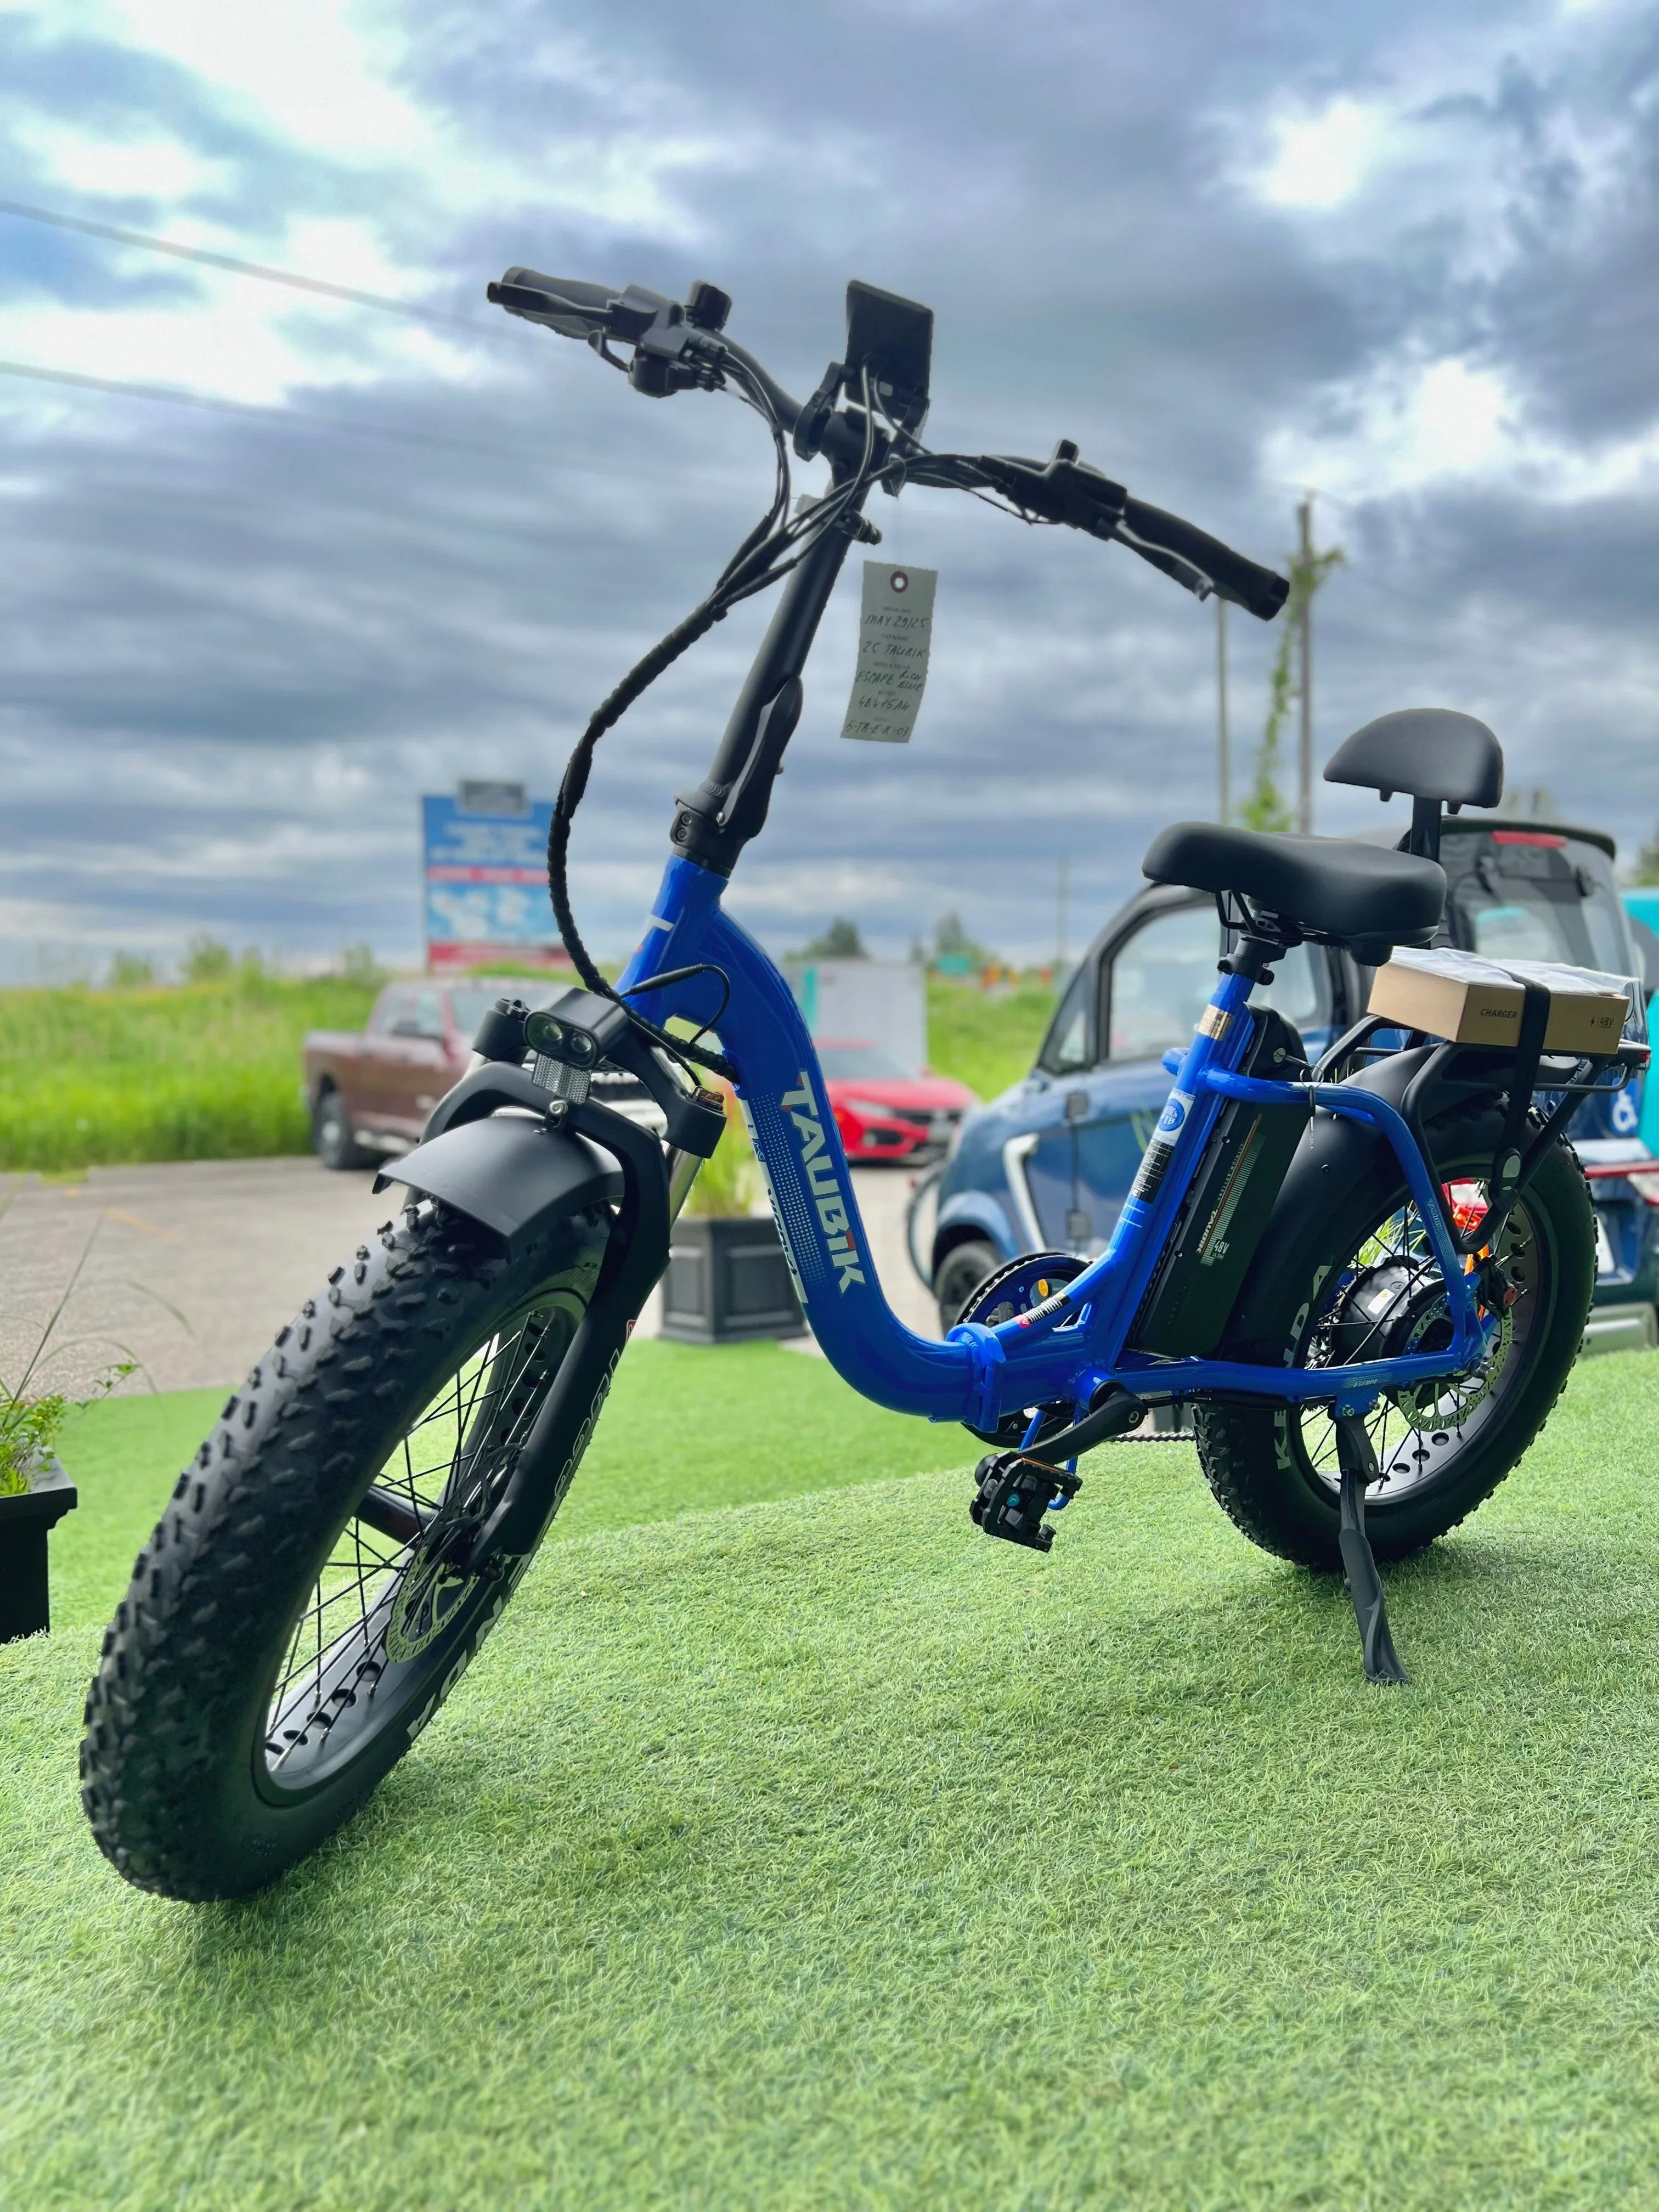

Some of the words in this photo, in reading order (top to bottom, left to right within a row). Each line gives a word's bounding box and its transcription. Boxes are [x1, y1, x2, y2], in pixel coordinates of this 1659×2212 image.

[865, 614, 891, 626] MAY
[855, 670, 895, 686] ESCAPE
[1480, 1008, 1518, 1019] CHARGER
[781, 1070, 866, 1295] TAUBIK
[1214, 1240, 1230, 1255] 48V
